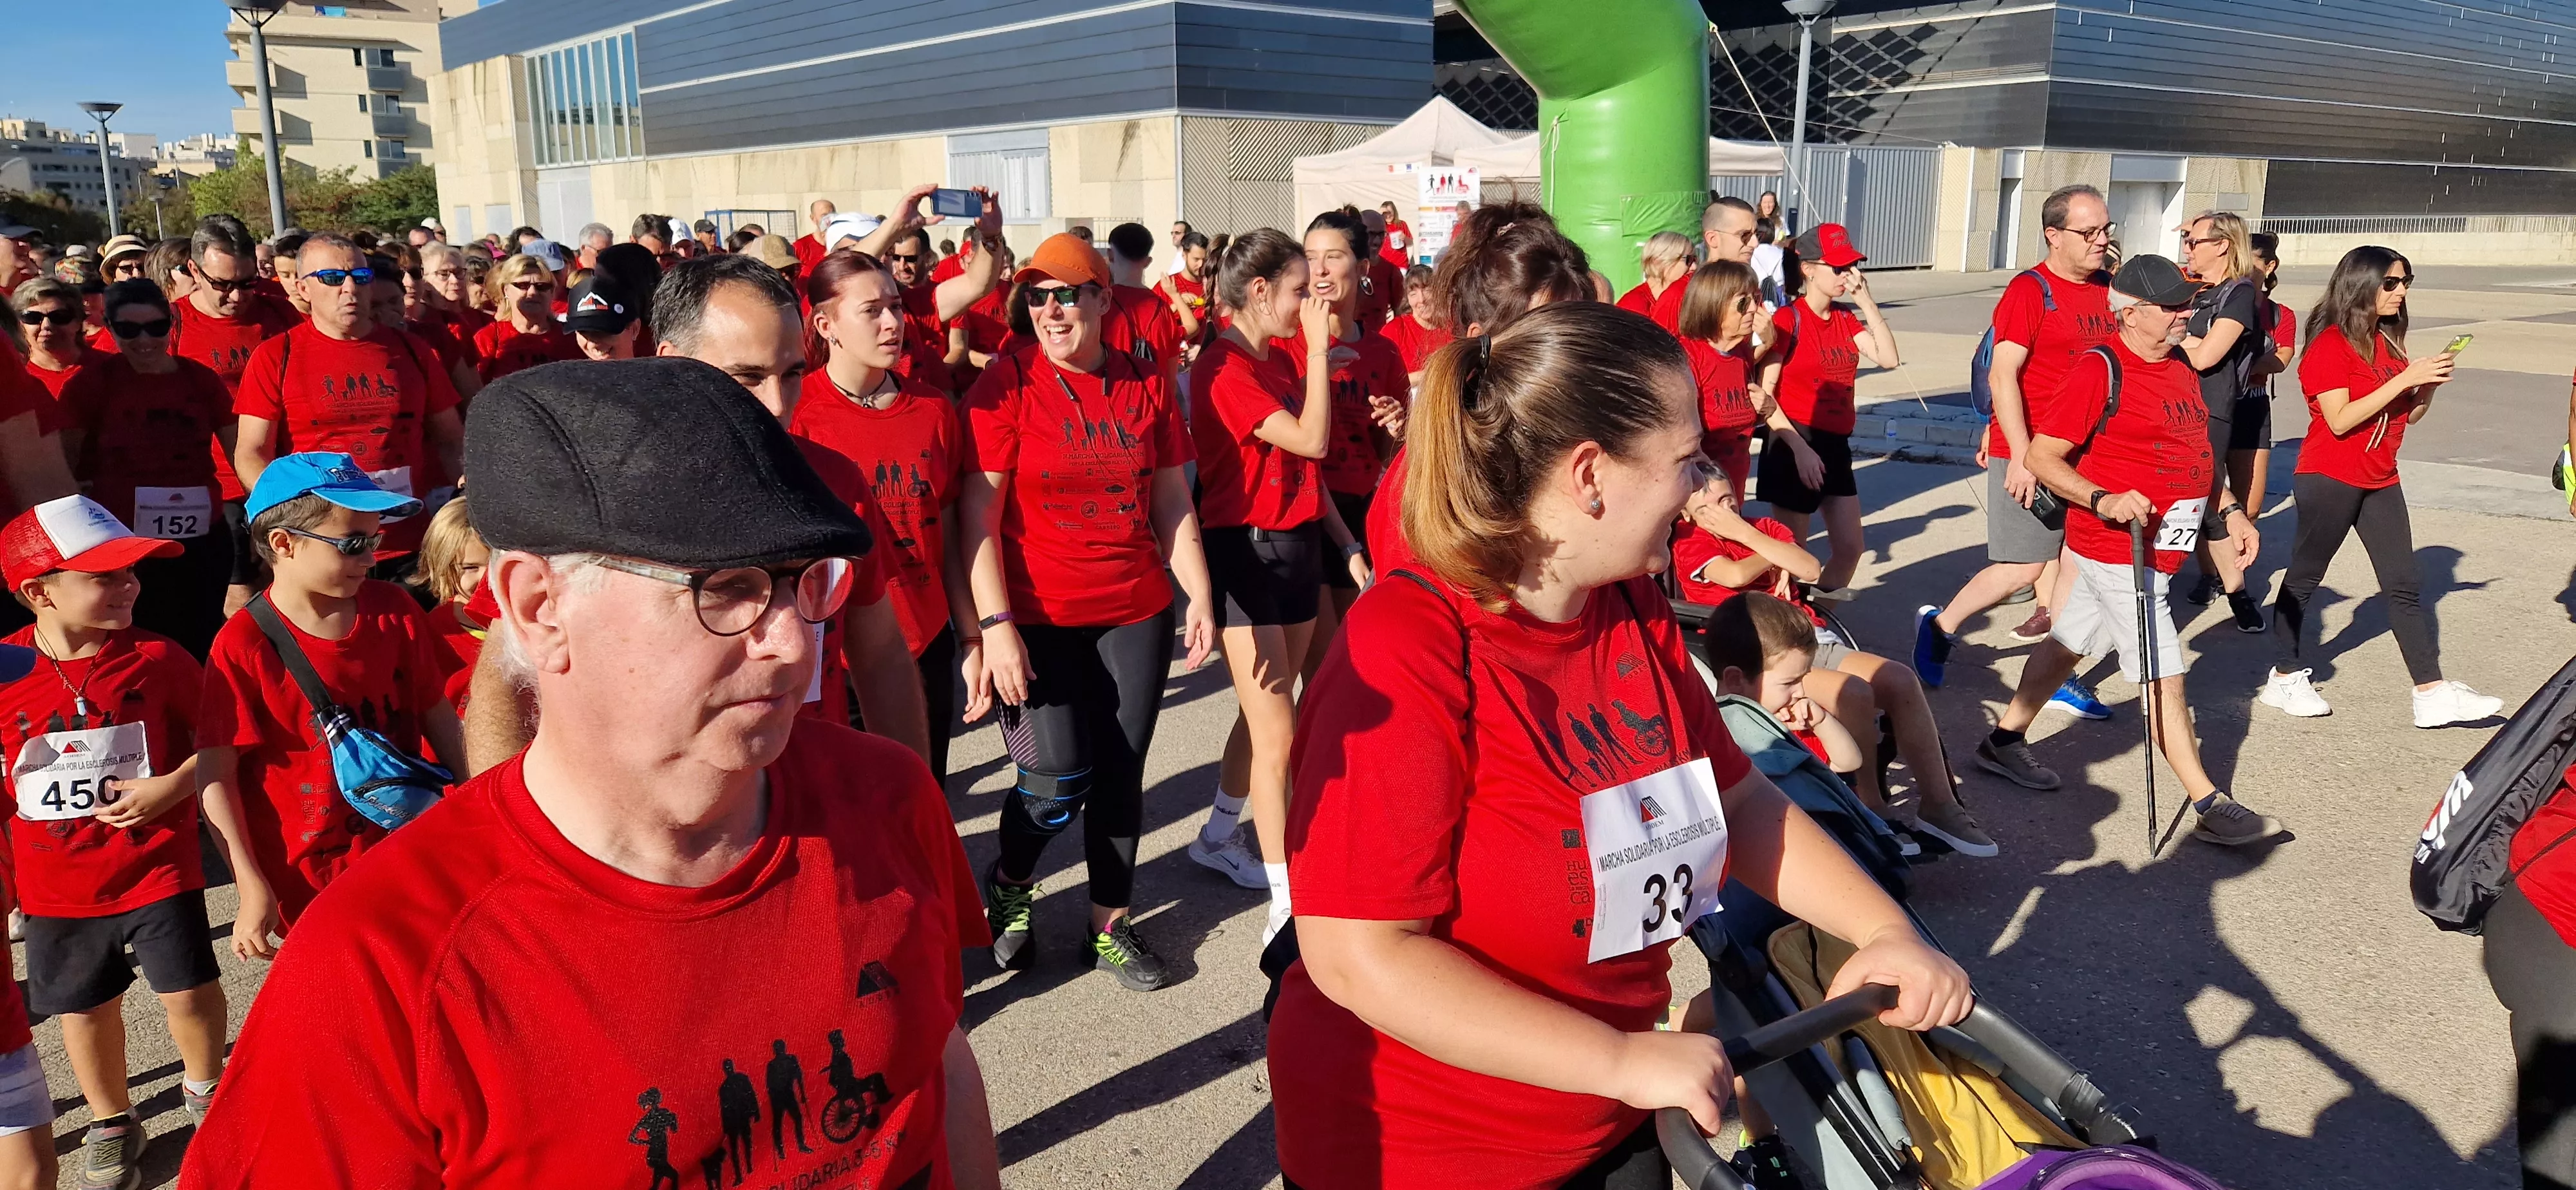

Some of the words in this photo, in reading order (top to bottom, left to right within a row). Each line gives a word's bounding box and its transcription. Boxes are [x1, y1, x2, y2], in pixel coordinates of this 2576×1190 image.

[2249, 386, 2266, 399] NIK
[152, 515, 197, 535] 152
[2168, 528, 2197, 545] 27
[66, 762, 77, 771] POR
[78, 761, 86, 770] LA
[86, 756, 118, 770] ESCLEROSIS
[40, 775, 122, 812] 450
[1215, 804, 1239, 816] adidas
[1600, 851, 1624, 873] MARCHA
[1624, 840, 1654, 864] SOLIDARIA
[1651, 836, 1667, 855] POR
[1664, 835, 1671, 850] LA
[1669, 822, 1700, 847] ESCLEROSIS
[1643, 864, 1693, 933] 33
